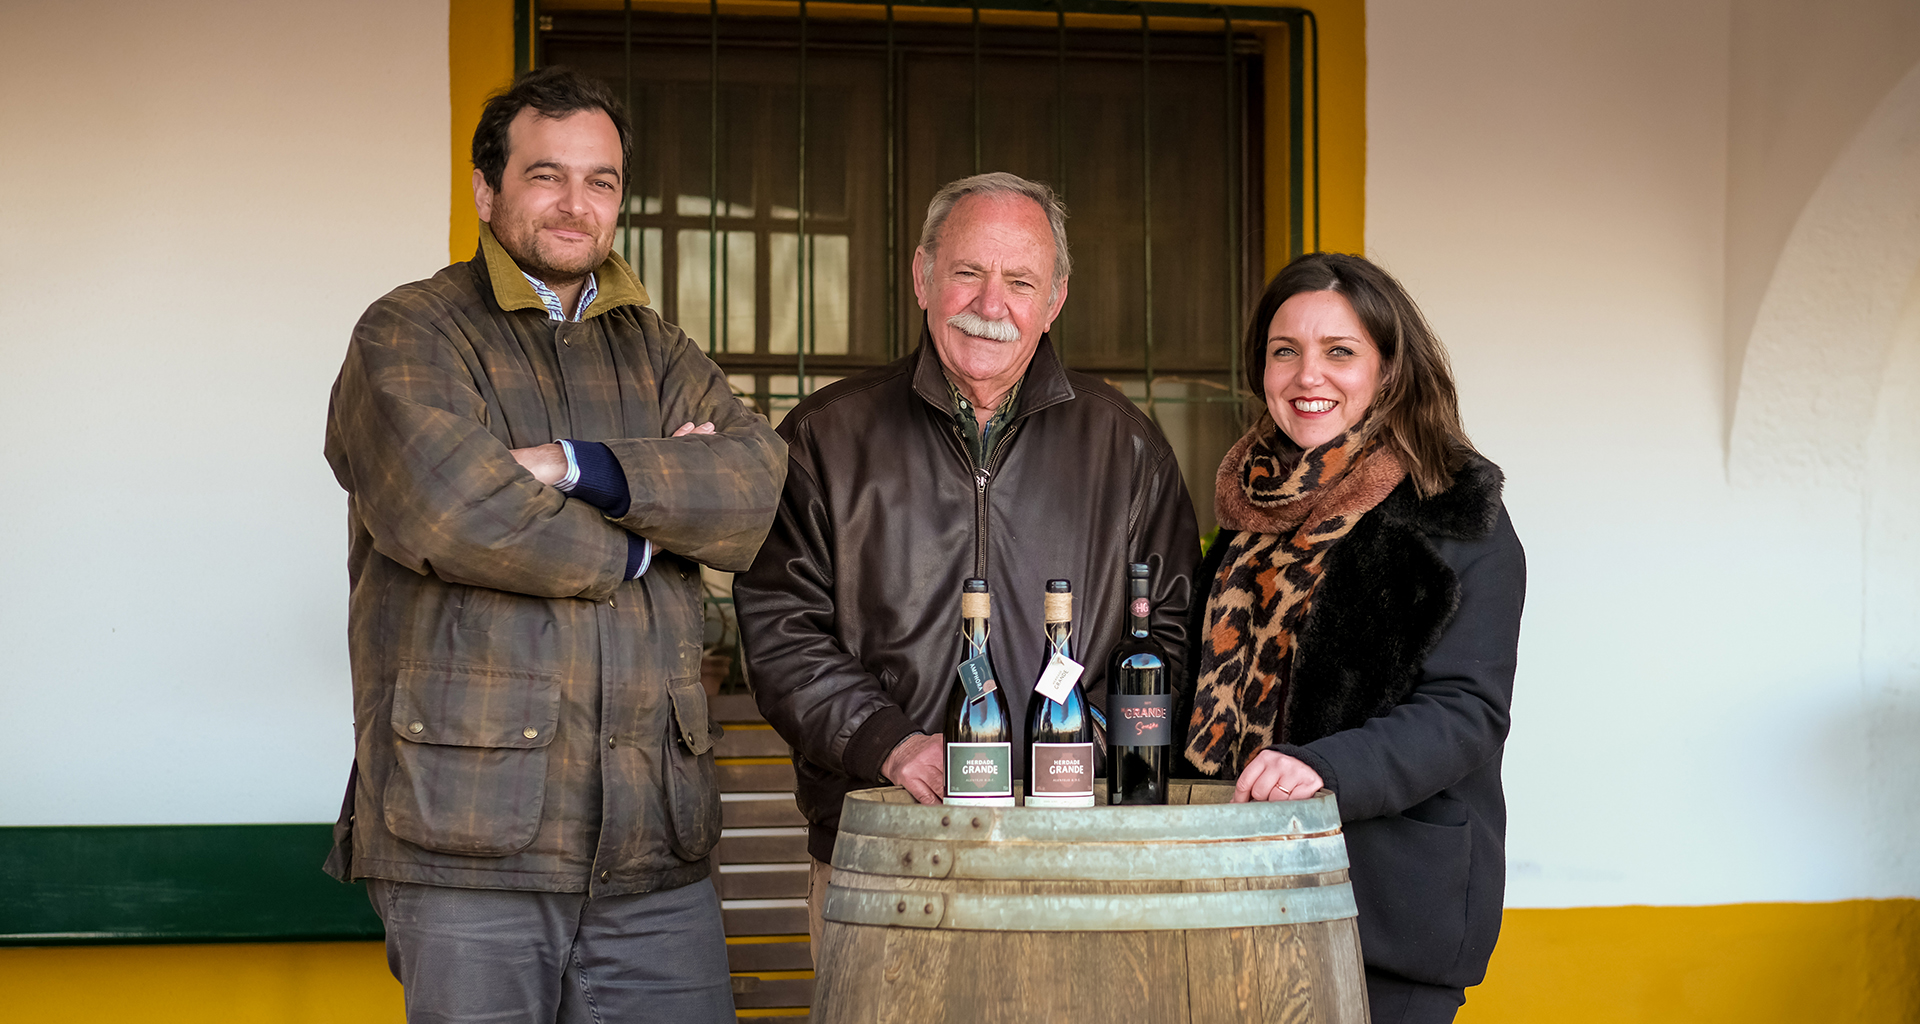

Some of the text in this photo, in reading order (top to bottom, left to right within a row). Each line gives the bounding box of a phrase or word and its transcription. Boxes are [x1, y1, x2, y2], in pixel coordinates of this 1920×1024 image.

[969, 663, 983, 691] AMPHORA
[1053, 669, 1069, 690] GRANDE
[1124, 707, 1166, 719] GRANDE
[962, 765, 998, 775] GRANDE
[1049, 765, 1084, 775] GRANDE
